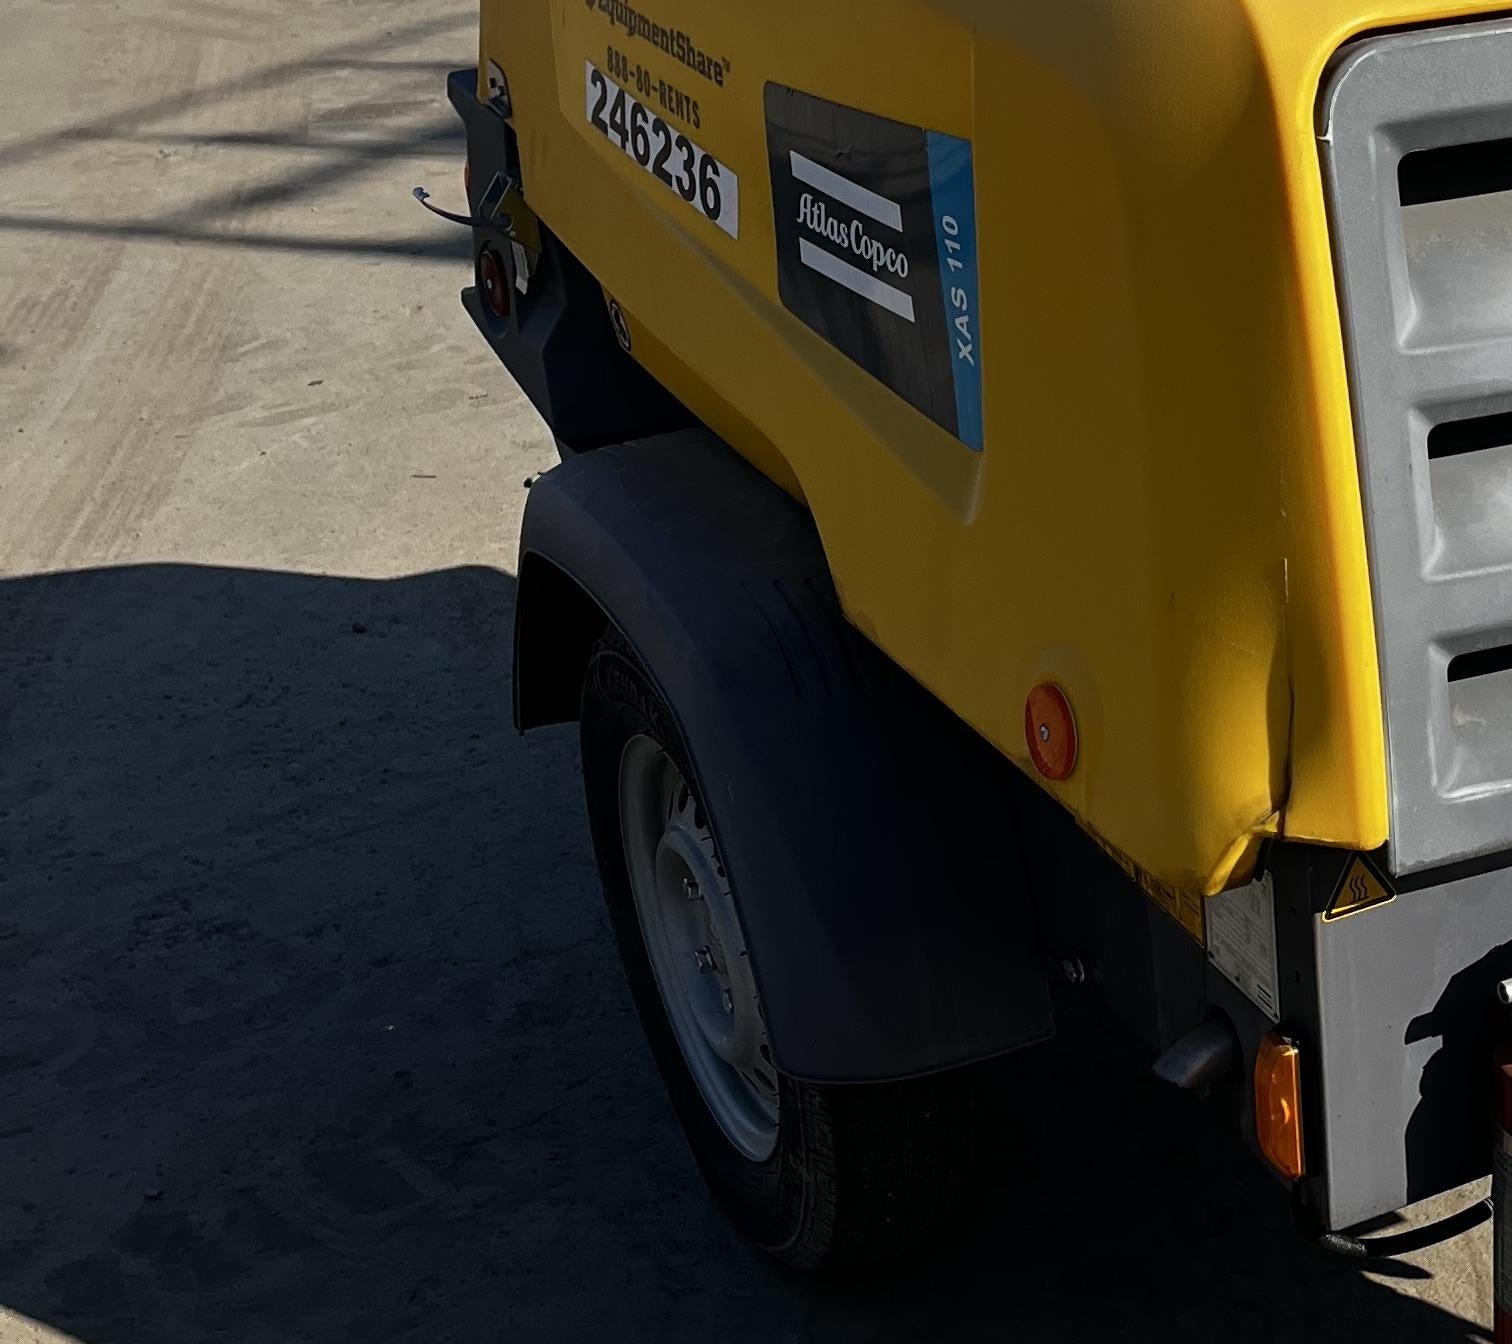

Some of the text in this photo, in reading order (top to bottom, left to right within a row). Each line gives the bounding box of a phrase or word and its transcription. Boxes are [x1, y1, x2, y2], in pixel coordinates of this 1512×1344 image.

[591, 68, 721, 221] 246236
[607, 45, 700, 129] 888-80-RENTS
[942, 215, 975, 366] XAS 110
